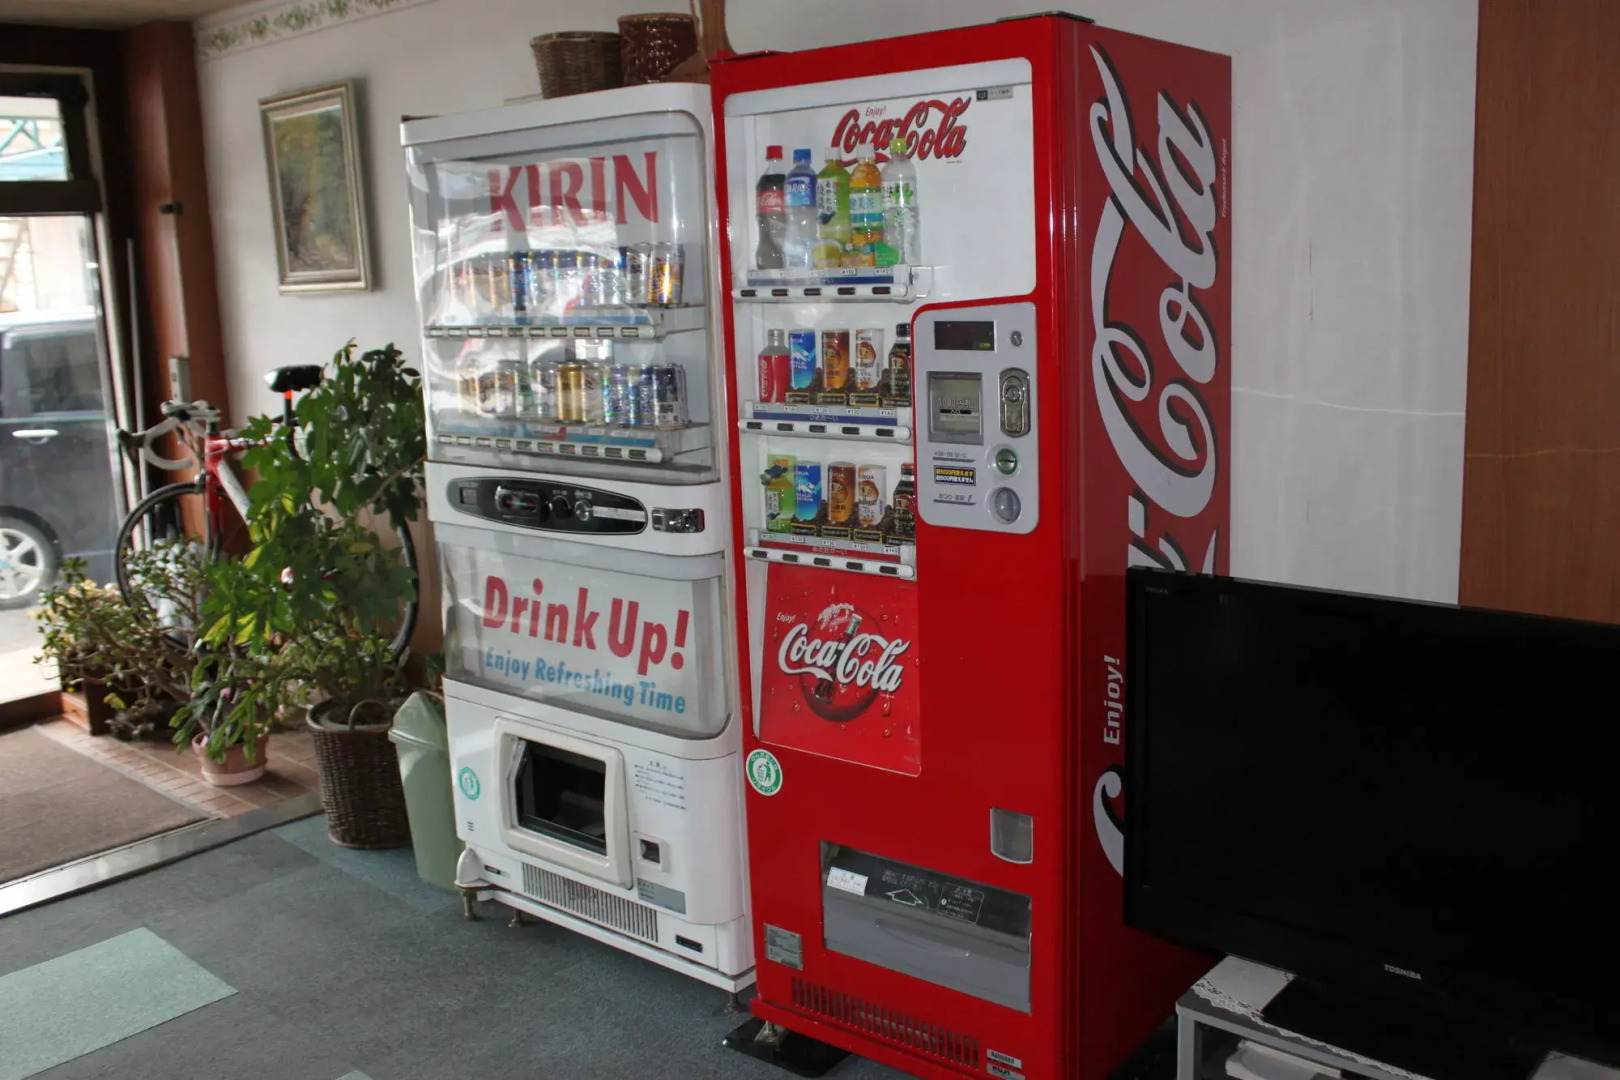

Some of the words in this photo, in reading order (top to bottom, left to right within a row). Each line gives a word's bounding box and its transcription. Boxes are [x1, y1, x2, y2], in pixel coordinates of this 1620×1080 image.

[831, 96, 972, 167] Coca-Cola
[865, 105, 887, 117] Enjoy!
[486, 151, 659, 233] KIRIN
[482, 574, 600, 651] Drink
[607, 597, 690, 677] Up!
[776, 611, 797, 623] Enjoy!
[484, 646, 531, 681] Enjoy
[534, 658, 635, 708] Refreshing
[639, 681, 686, 714] Time
[777, 623, 912, 692] Coca-Cola
[1103, 654, 1124, 745] Enjoy!
[1384, 963, 1422, 981] TOSHIBA
